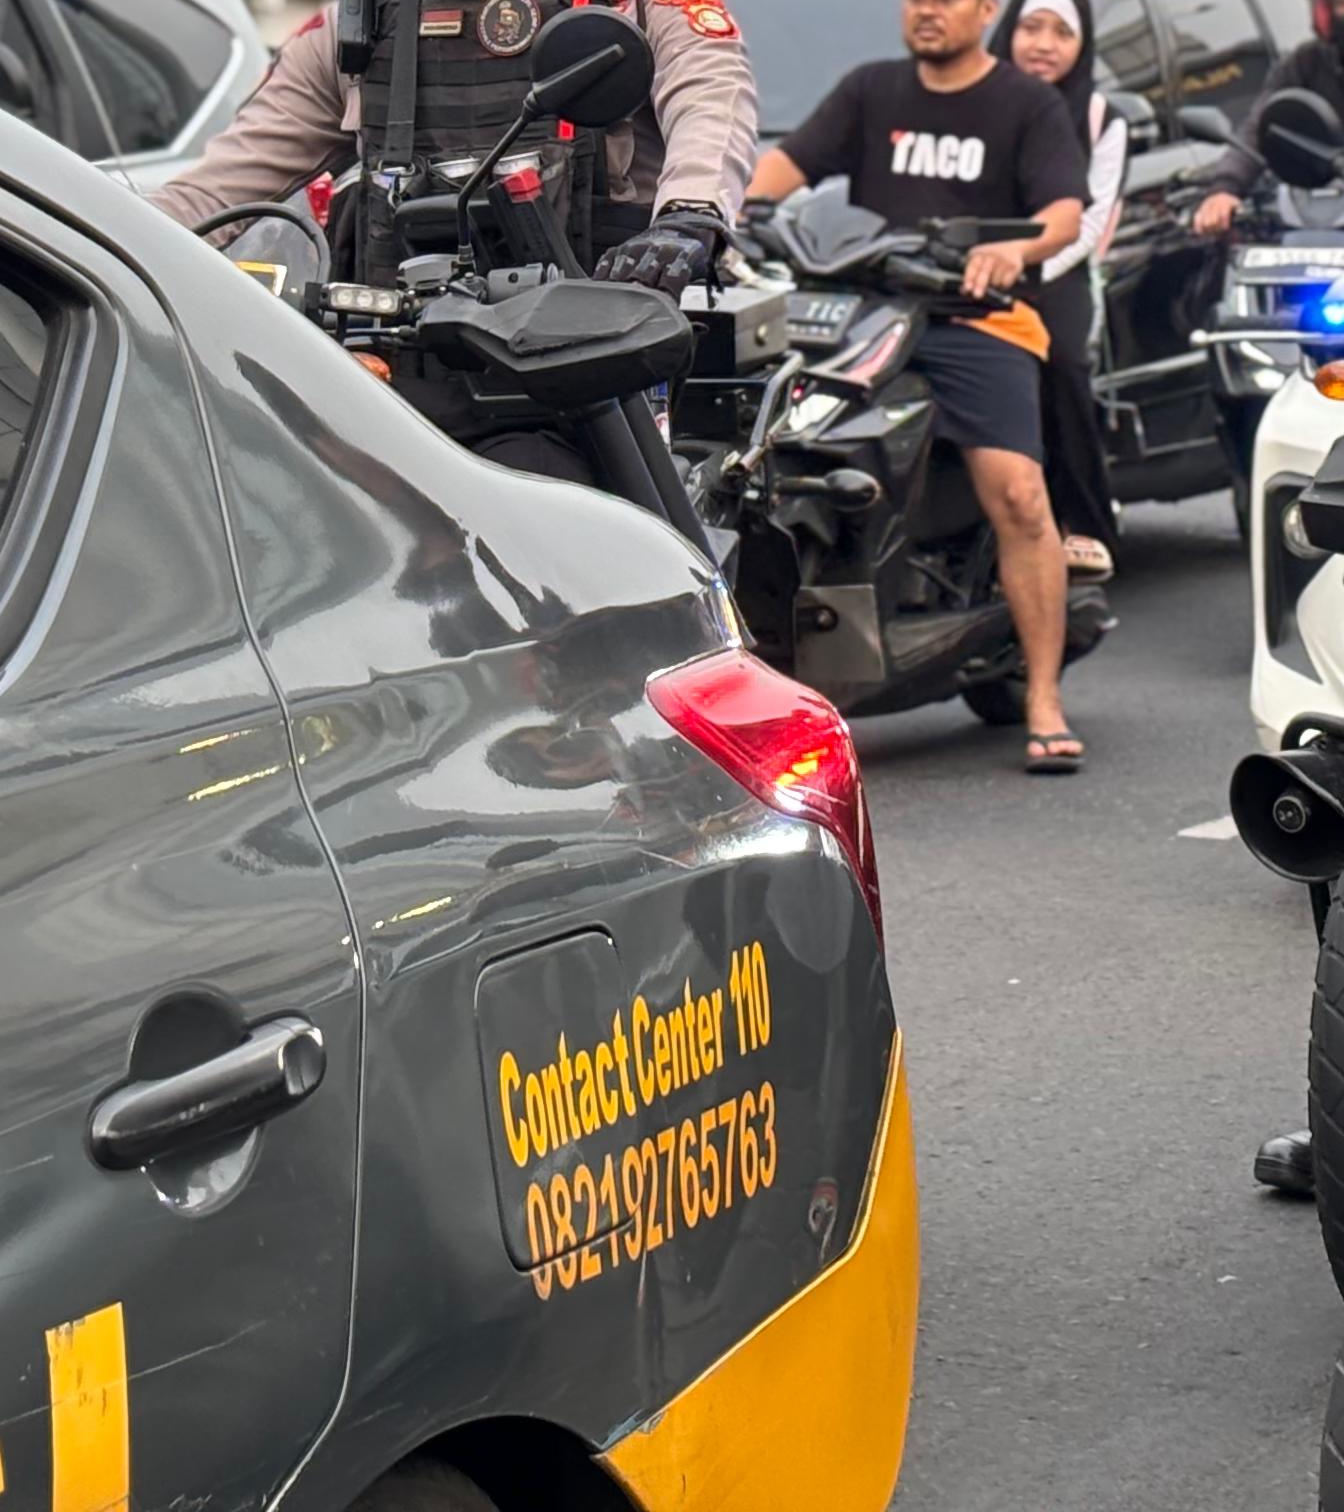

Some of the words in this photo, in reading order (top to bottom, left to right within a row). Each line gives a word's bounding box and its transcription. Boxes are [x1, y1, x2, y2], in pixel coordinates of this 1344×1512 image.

[889, 129, 986, 182] TACO
[500, 1009, 636, 1167] Contact
[631, 977, 724, 1107] Center
[729, 941, 771, 1055] 110
[525, 1080, 776, 1300] 082192765763
